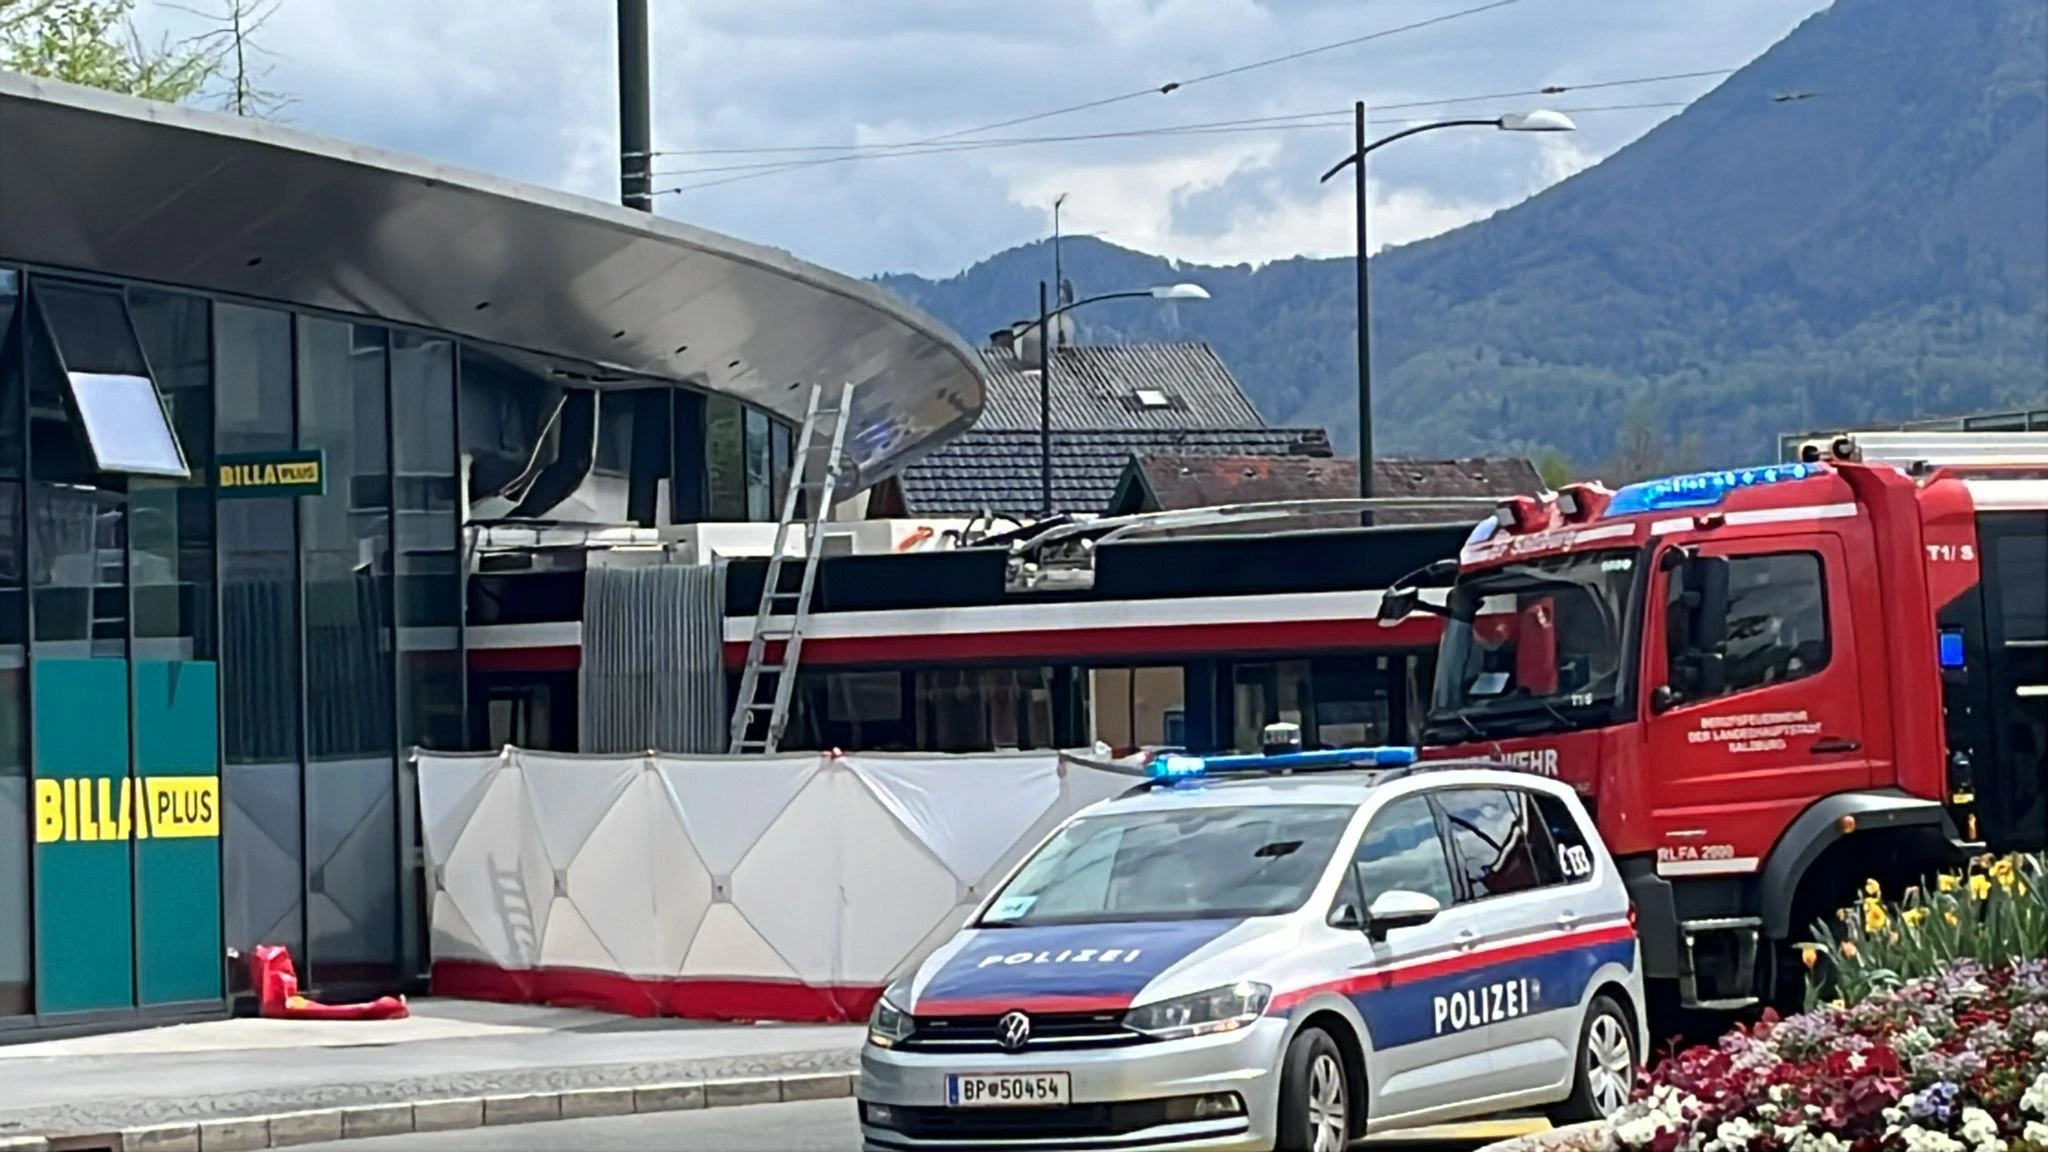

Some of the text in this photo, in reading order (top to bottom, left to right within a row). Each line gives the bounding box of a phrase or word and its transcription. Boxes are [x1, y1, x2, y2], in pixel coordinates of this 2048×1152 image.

[220, 464, 315, 486] BILLA PLUS
[35, 777, 212, 843] BILLA PLUS
[978, 949, 1141, 968] POLIZEI
[1434, 978, 1528, 1034] POLIZEI
[964, 1078, 1058, 1101] BP 50454
